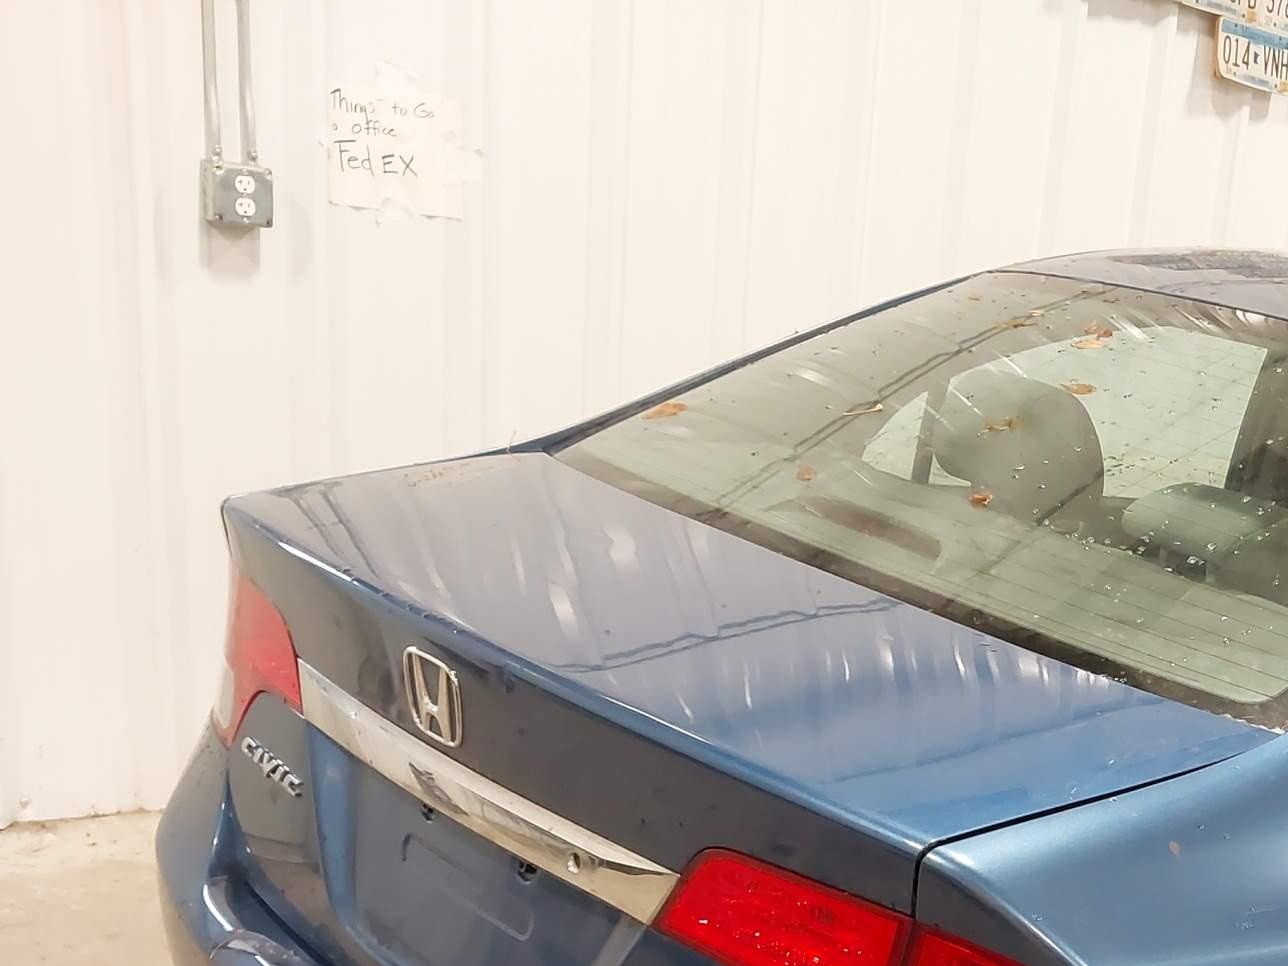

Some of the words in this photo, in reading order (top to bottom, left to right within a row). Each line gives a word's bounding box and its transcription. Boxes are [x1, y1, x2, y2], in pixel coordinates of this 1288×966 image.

[1223, 35, 1250, 71] 014
[1264, 44, 1288, 81] VNH
[392, 102, 408, 116] to
[240, 736, 303, 797] CIVIC
